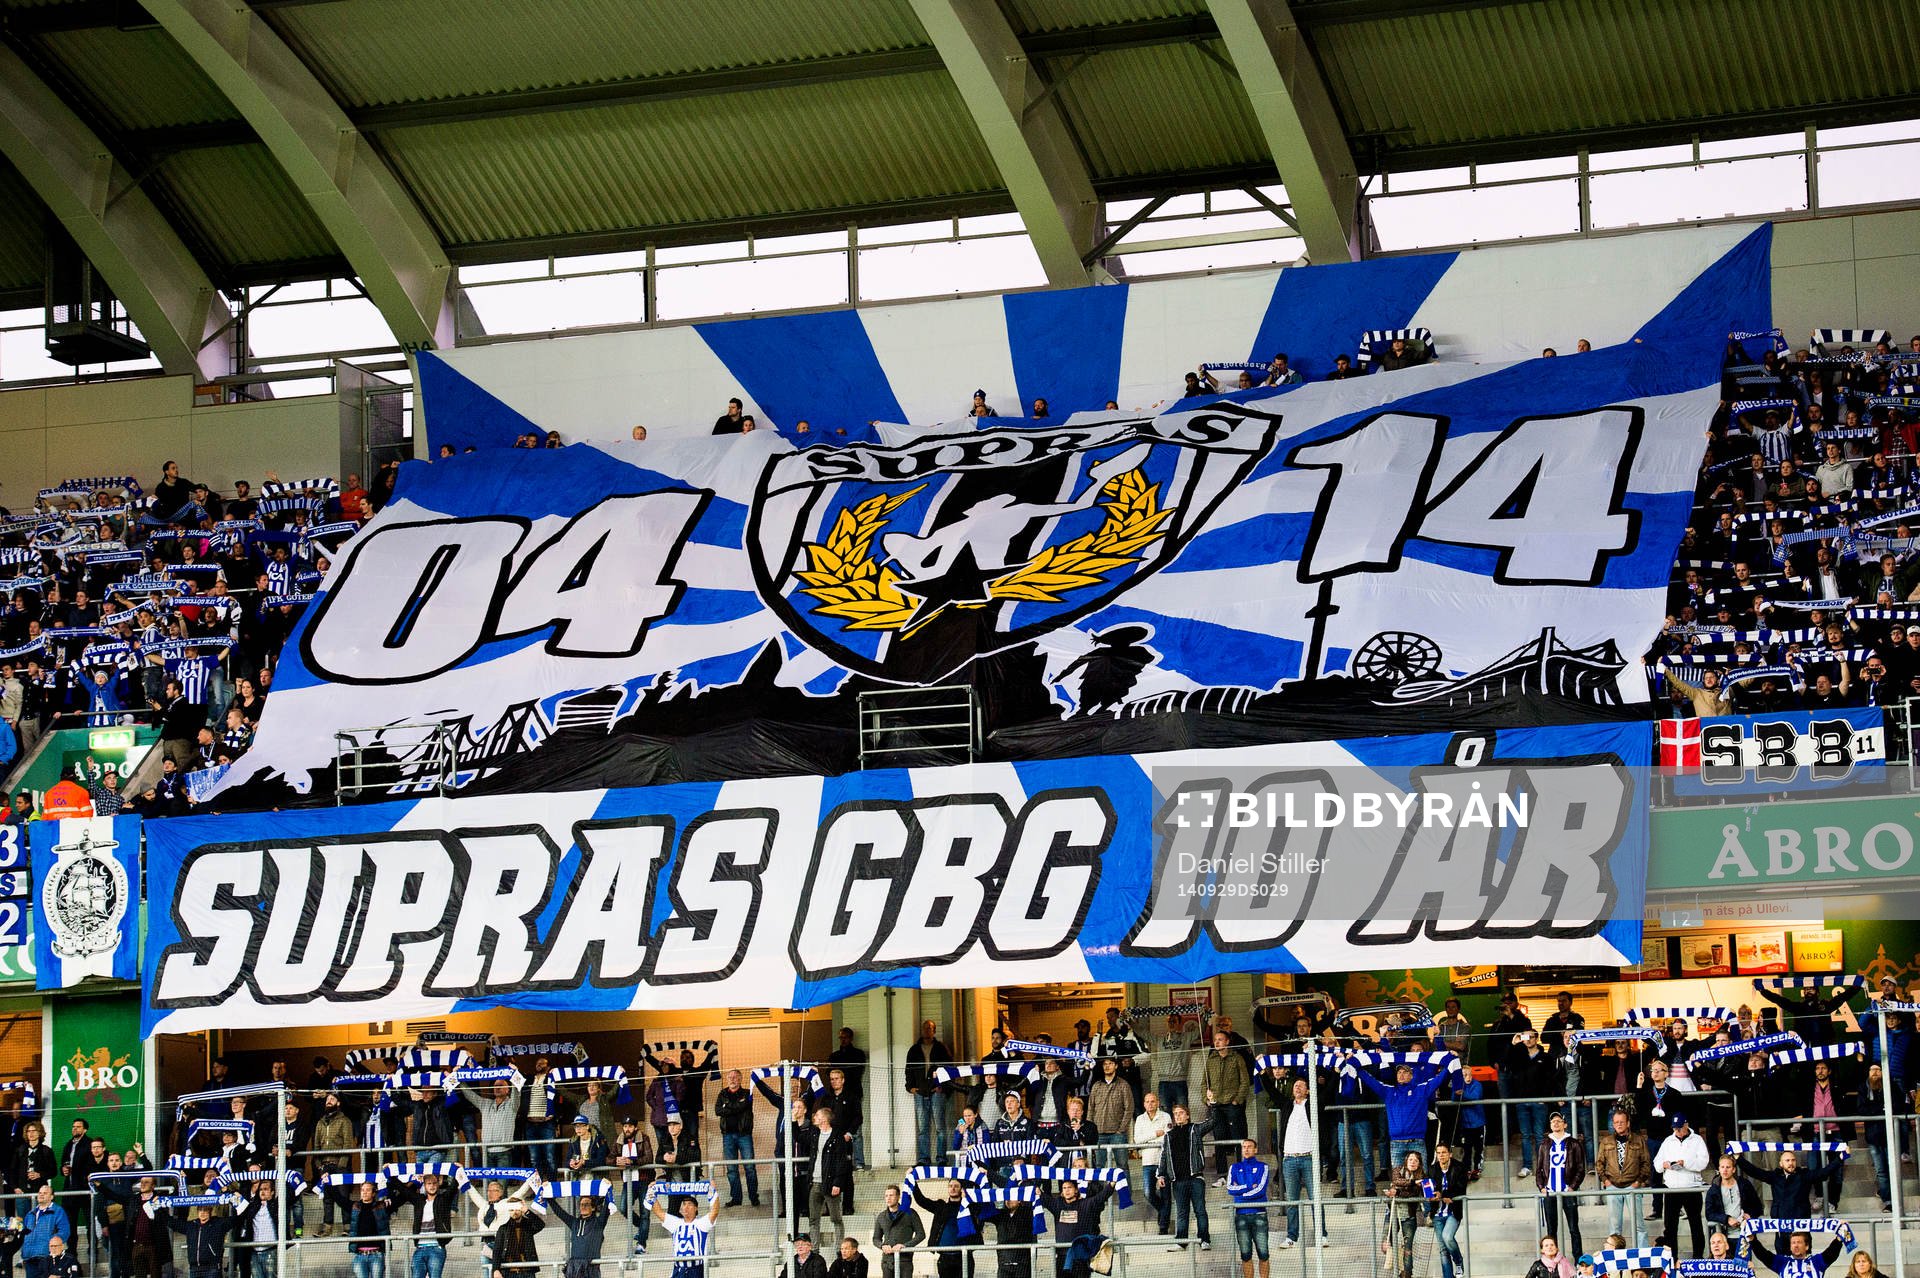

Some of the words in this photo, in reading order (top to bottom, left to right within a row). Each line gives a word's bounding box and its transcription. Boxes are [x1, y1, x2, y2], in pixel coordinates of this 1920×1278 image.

[807, 413, 1246, 480] SUPRAS
[1283, 405, 1645, 587] 14
[299, 488, 716, 686] 04
[1855, 735, 1876, 755] 11
[1707, 822, 1914, 880] ÅBRO
[150, 807, 781, 1008] SUPRAS
[787, 785, 1118, 982] GBG
[1119, 767, 1338, 958] 10
[1346, 729, 1636, 947] ÅR
[1672, 912, 1692, 927] 12
[1716, 904, 1735, 917] äts
[1738, 904, 1753, 917] på
[1756, 902, 1793, 914] Ullevi.
[1717, 1040, 1756, 1057] SKINER
[54, 1065, 139, 1092] ÅBRO
[472, 1068, 514, 1080] GÖTEBORG
